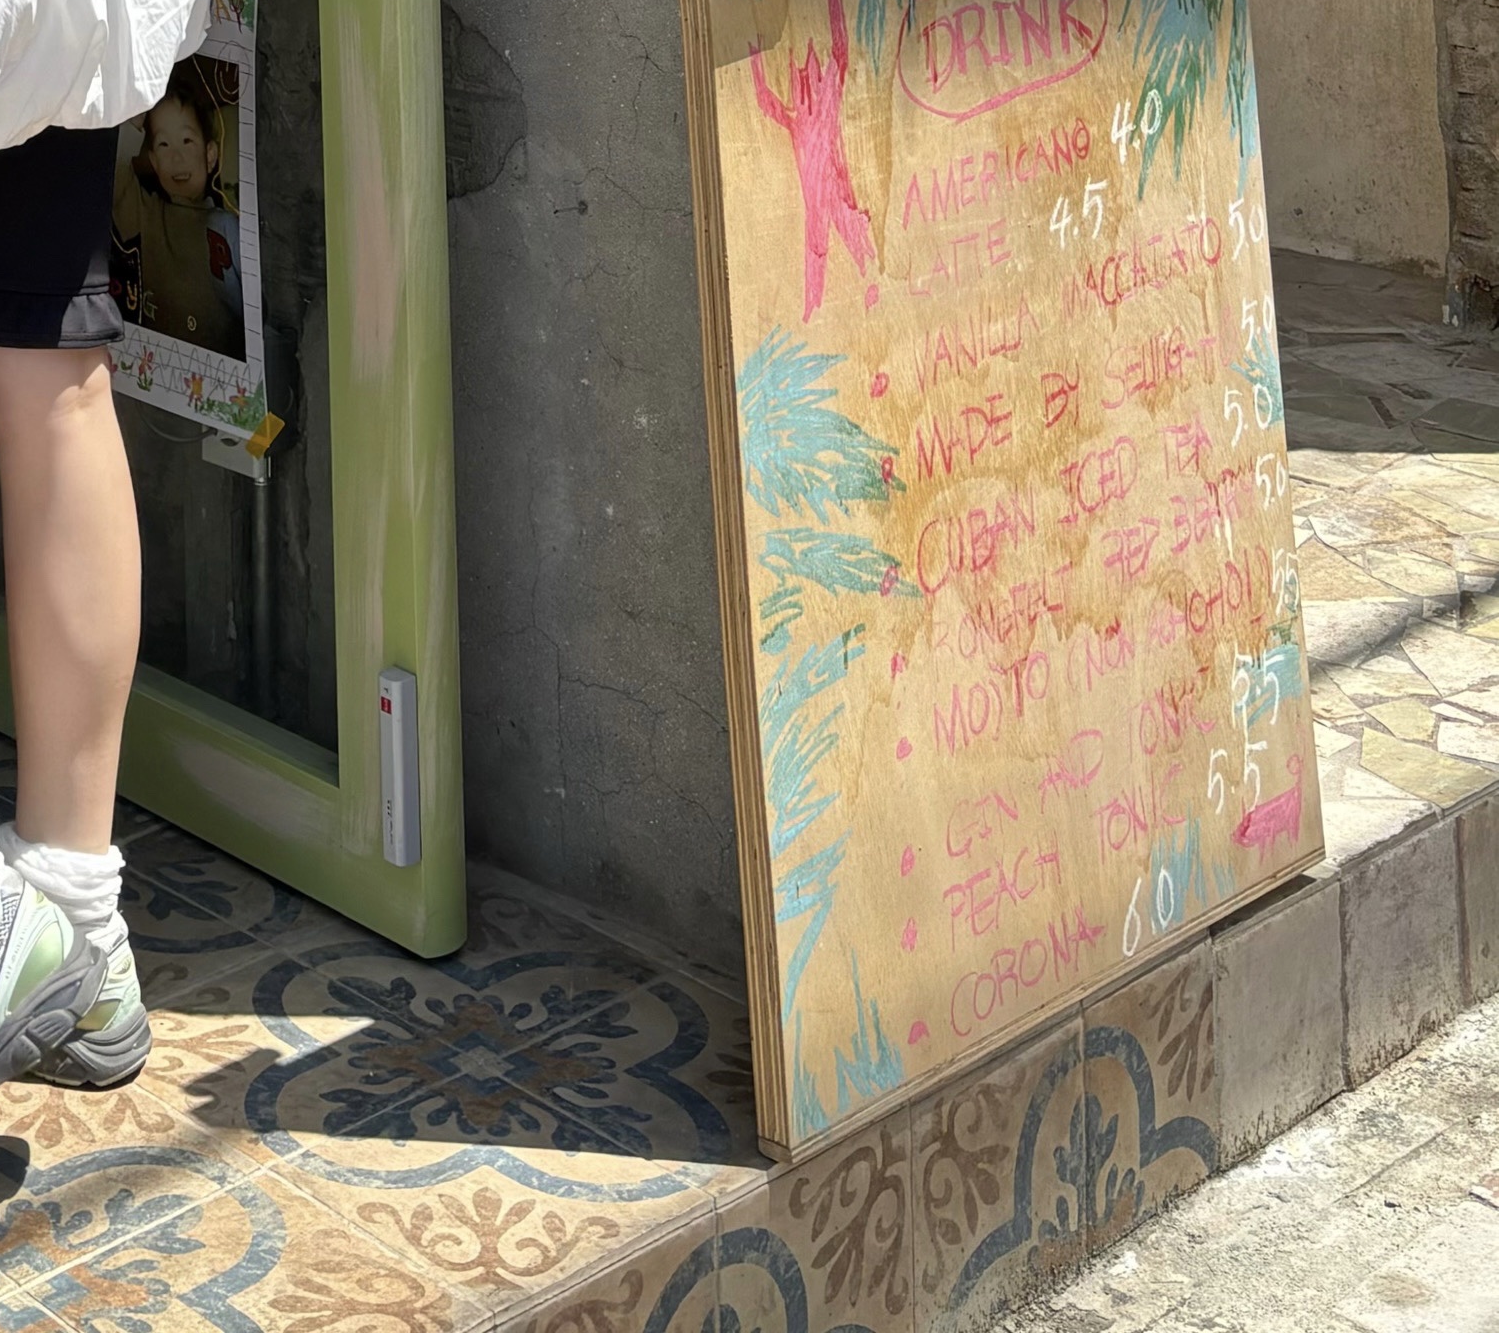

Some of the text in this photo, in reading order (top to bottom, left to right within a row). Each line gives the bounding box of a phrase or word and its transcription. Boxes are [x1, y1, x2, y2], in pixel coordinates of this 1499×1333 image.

[902, 89, 1163, 231] AMERICANO 4.0
[905, 177, 1108, 297] LATTE 4.5
[915, 392, 1013, 483] MADE
[1041, 359, 1081, 429] BY
[917, 480, 1036, 596] CUBAN
[1058, 435, 1139, 525] ICED
[1223, 383, 1274, 448] 5.0
[943, 830, 1062, 953] PEACH
[1094, 763, 1186, 865] TONIC
[950, 897, 1106, 1037] CORONA
